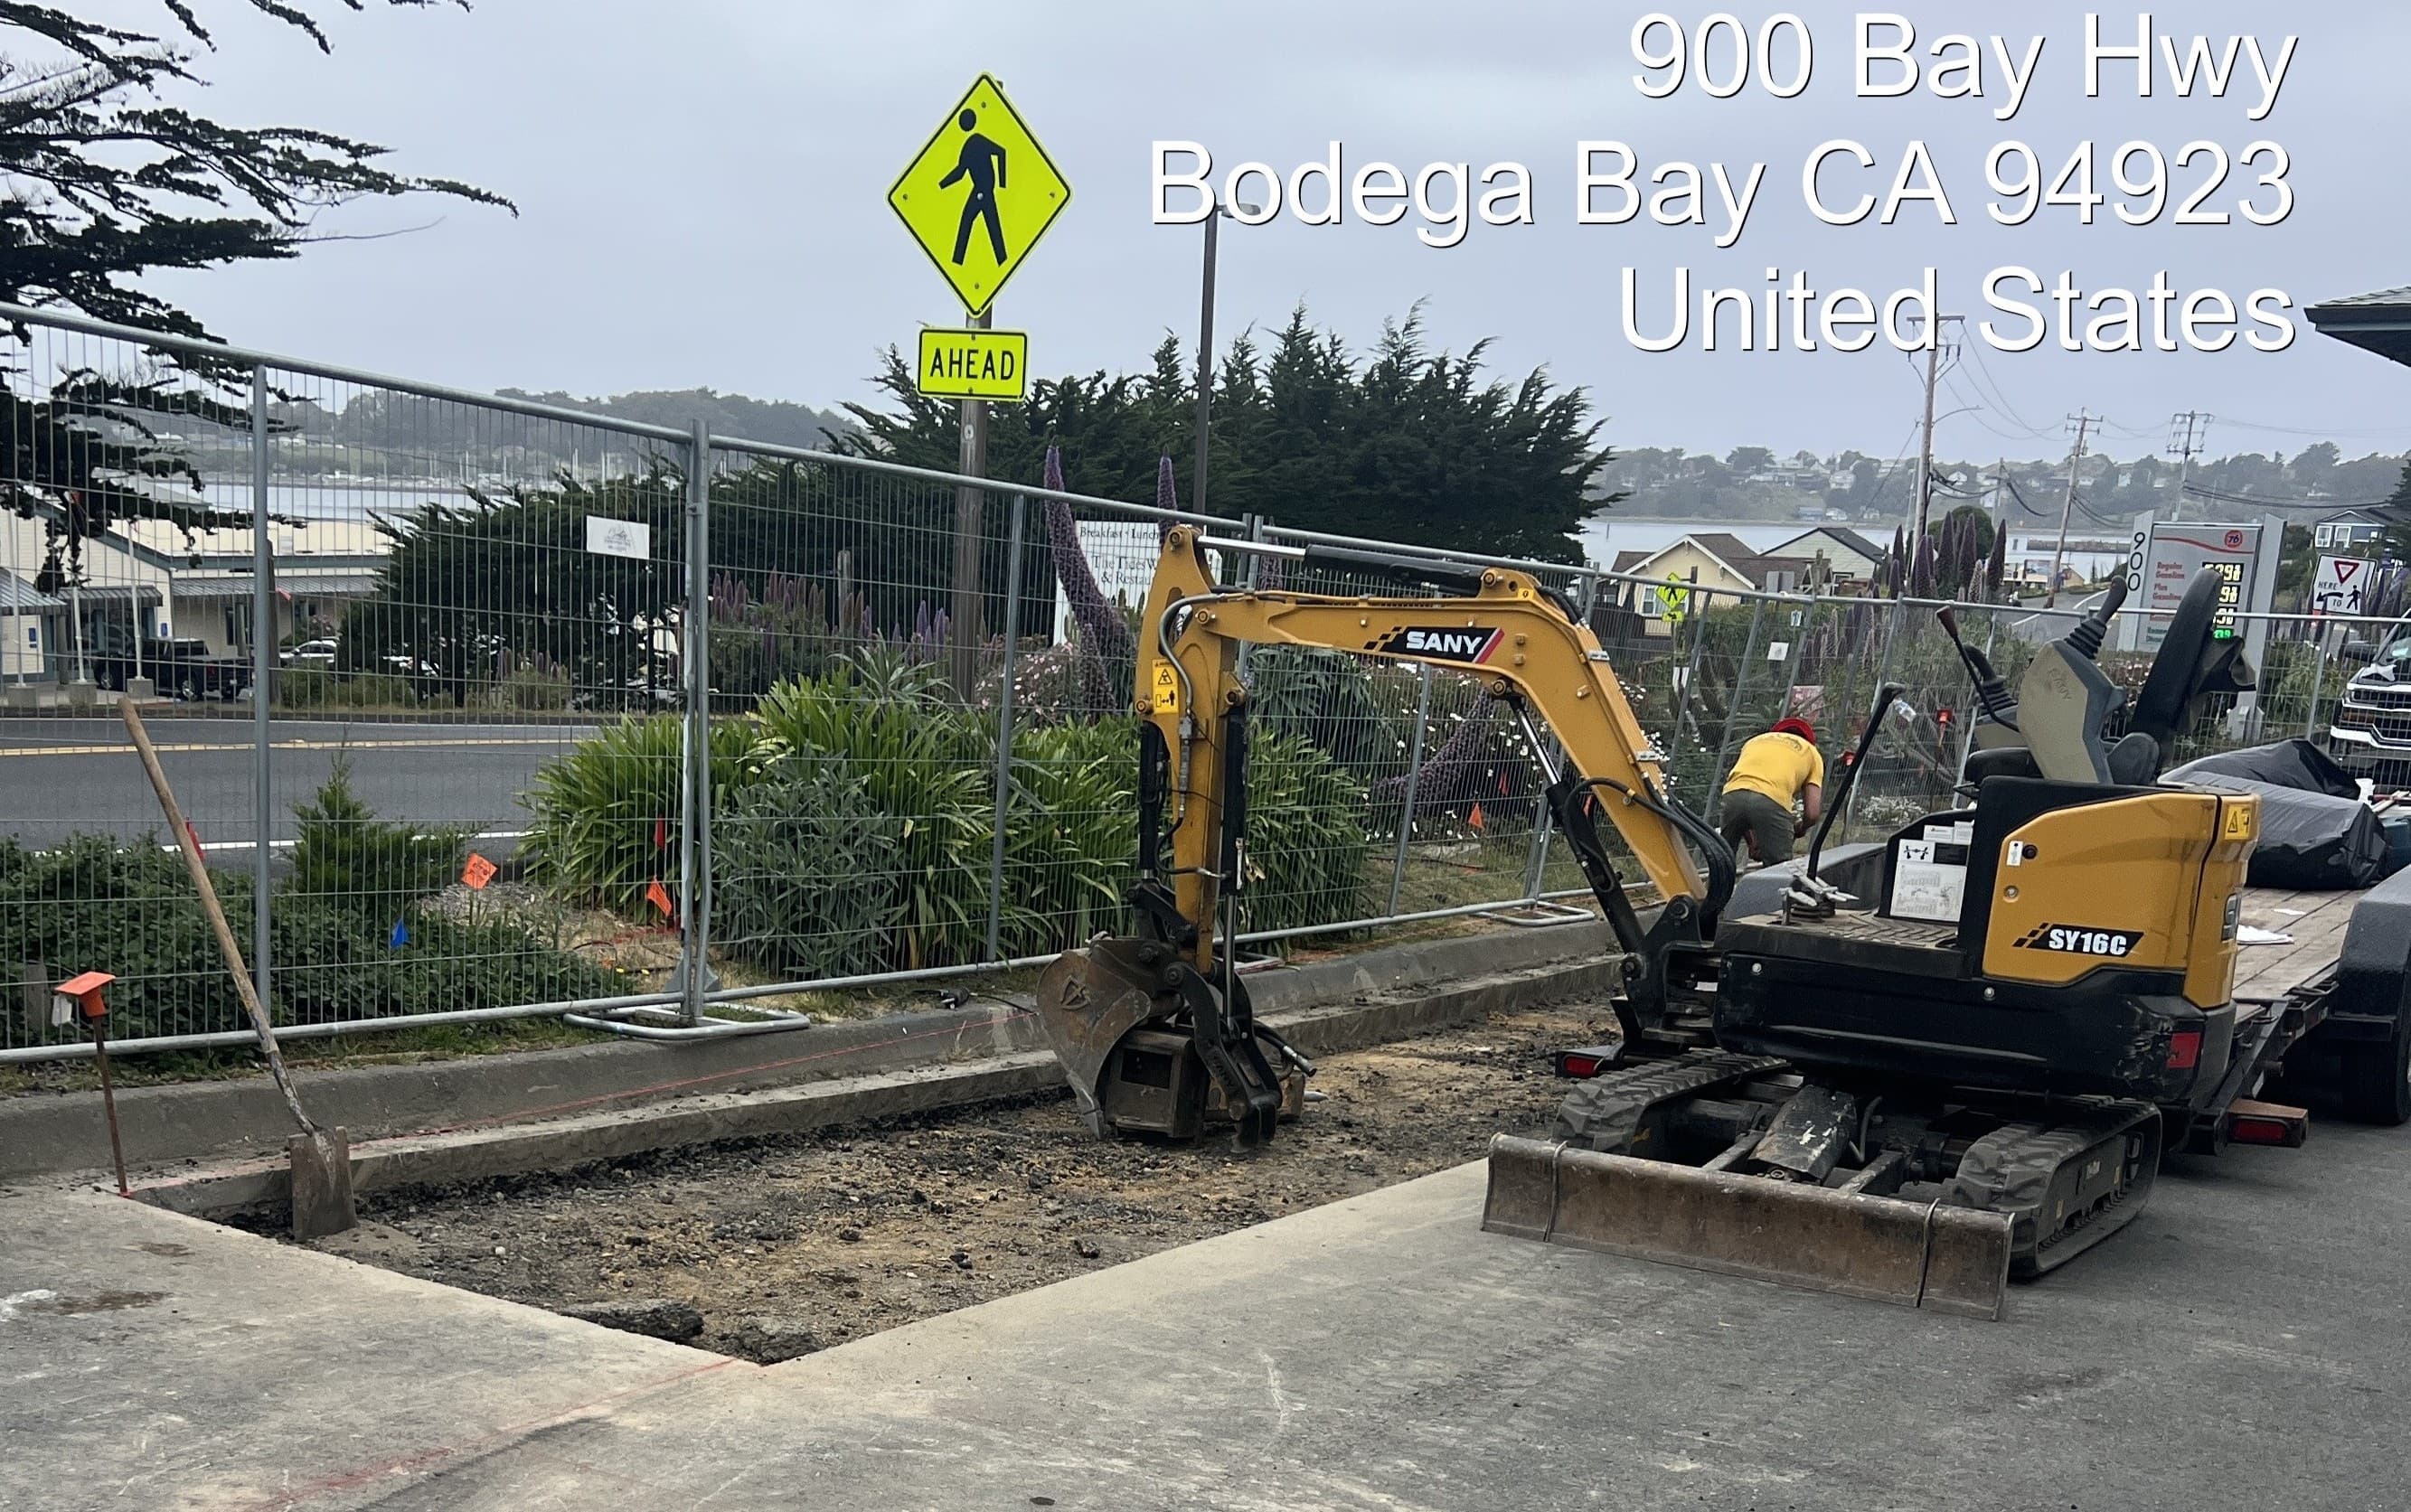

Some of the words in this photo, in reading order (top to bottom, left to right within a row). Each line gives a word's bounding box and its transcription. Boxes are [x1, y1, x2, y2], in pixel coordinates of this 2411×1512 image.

[929, 347, 1014, 380] AHEAD
[1080, 527, 1123, 538] Breakfast
[1131, 528, 1159, 540] Lunch
[2227, 534, 2239, 544] 76
[2127, 531, 2146, 592] 900
[2318, 581, 2338, 590] HERE
[2332, 599, 2342, 607] TO
[1406, 631, 1483, 654] SANY
[2048, 928, 2127, 955] SY16C
